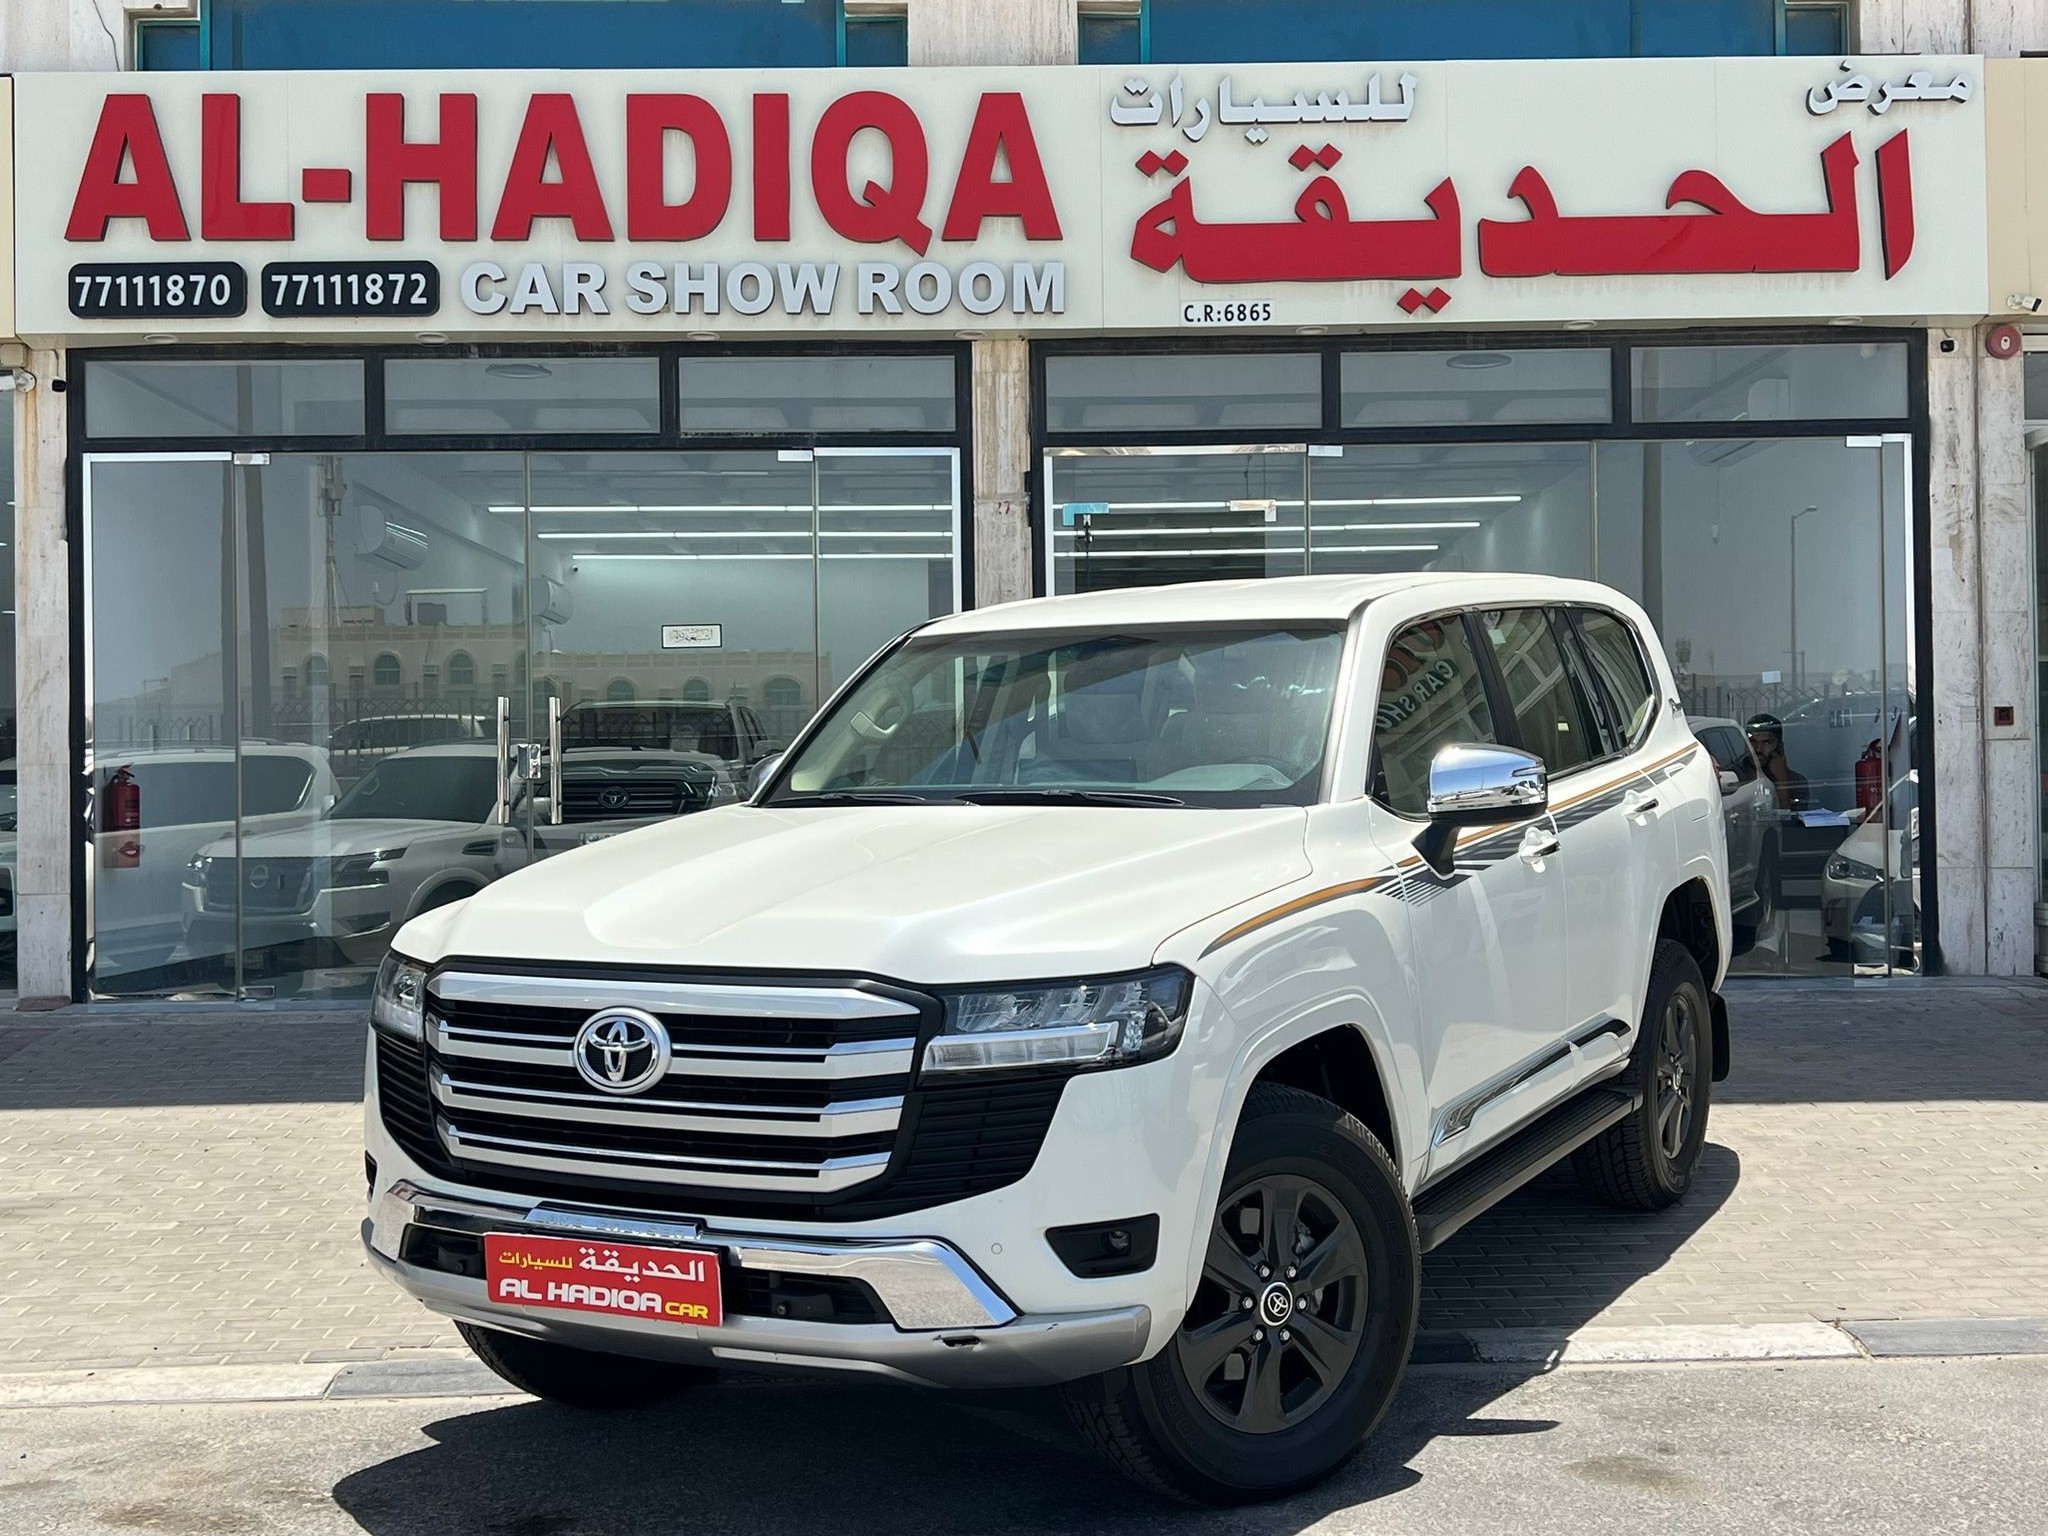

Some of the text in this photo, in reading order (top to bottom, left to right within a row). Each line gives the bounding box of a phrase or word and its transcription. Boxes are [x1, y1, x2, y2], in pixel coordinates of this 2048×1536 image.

[1110, 71, 1417, 142] للسيارات
[1806, 60, 1973, 115] معرض
[65, 91, 1062, 255] AL-HADIQA
[1131, 129, 1914, 313] الحديقة
[75, 274, 231, 307] 77111870
[271, 273, 427, 306] 77111872
[460, 261, 1065, 315] CAR SHOW ROOM
[1183, 303, 1272, 323] C.R:6865
[499, 1247, 705, 1283] الحديقة للسيارات
[500, 1278, 709, 1319] AL HADIQA CAR
